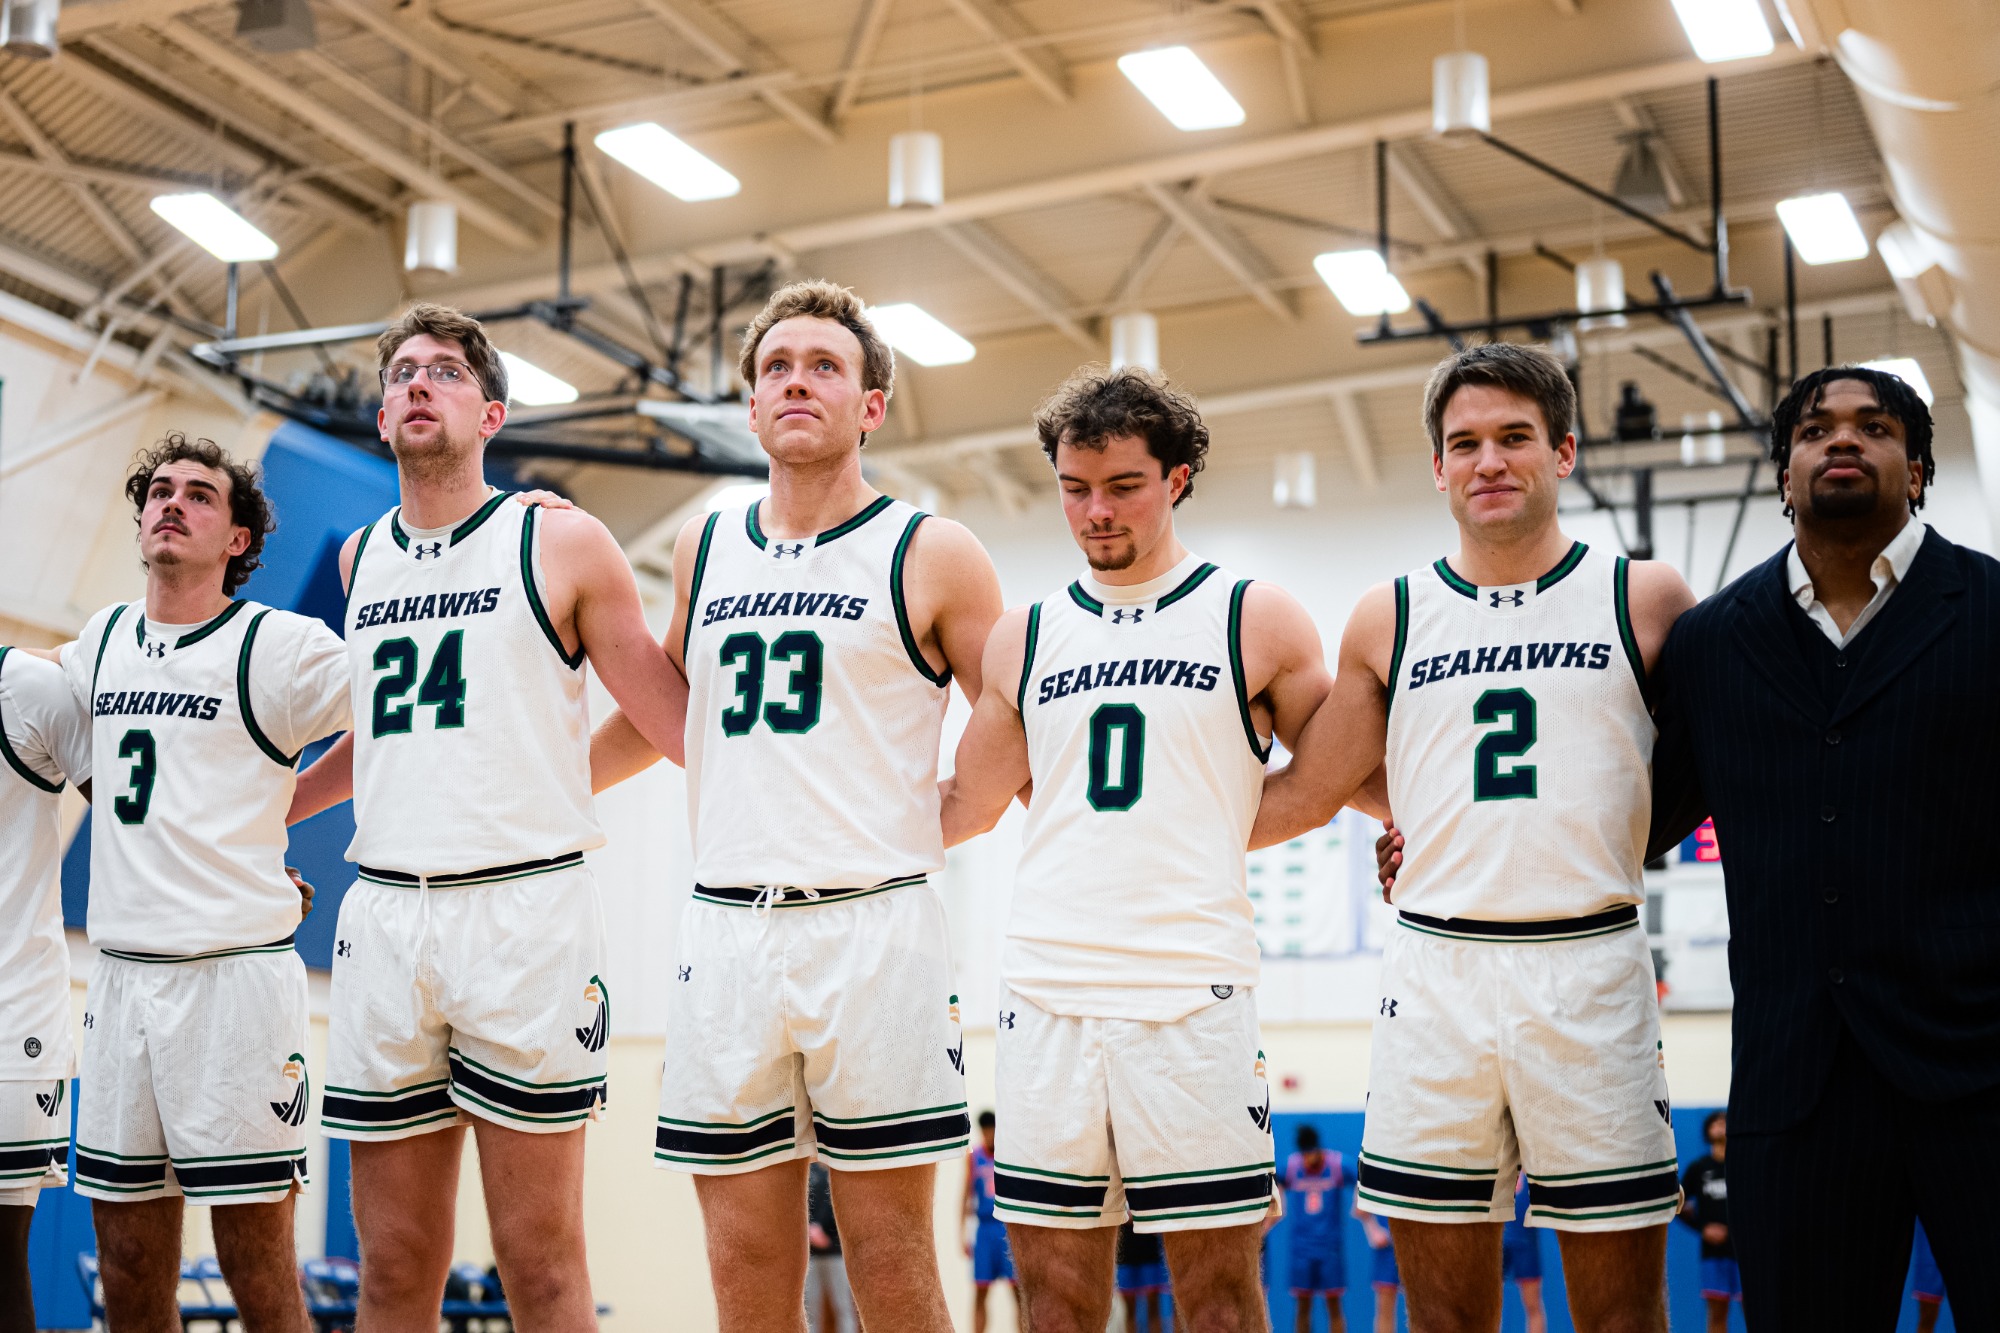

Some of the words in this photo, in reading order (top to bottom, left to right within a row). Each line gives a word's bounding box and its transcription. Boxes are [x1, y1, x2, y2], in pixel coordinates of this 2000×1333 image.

[355, 587, 502, 630] SEAHAWKS
[702, 592, 868, 627] SEAHAWKS
[372, 629, 467, 739] 24
[720, 631, 824, 738] 33
[1039, 659, 1221, 705] SEAHAWKS
[1409, 643, 1612, 690] SEAHAWKS
[94, 690, 222, 721] SEAHAWKS
[114, 729, 156, 825] 3
[1087, 703, 1145, 812] 0
[1473, 688, 1538, 802] 2
